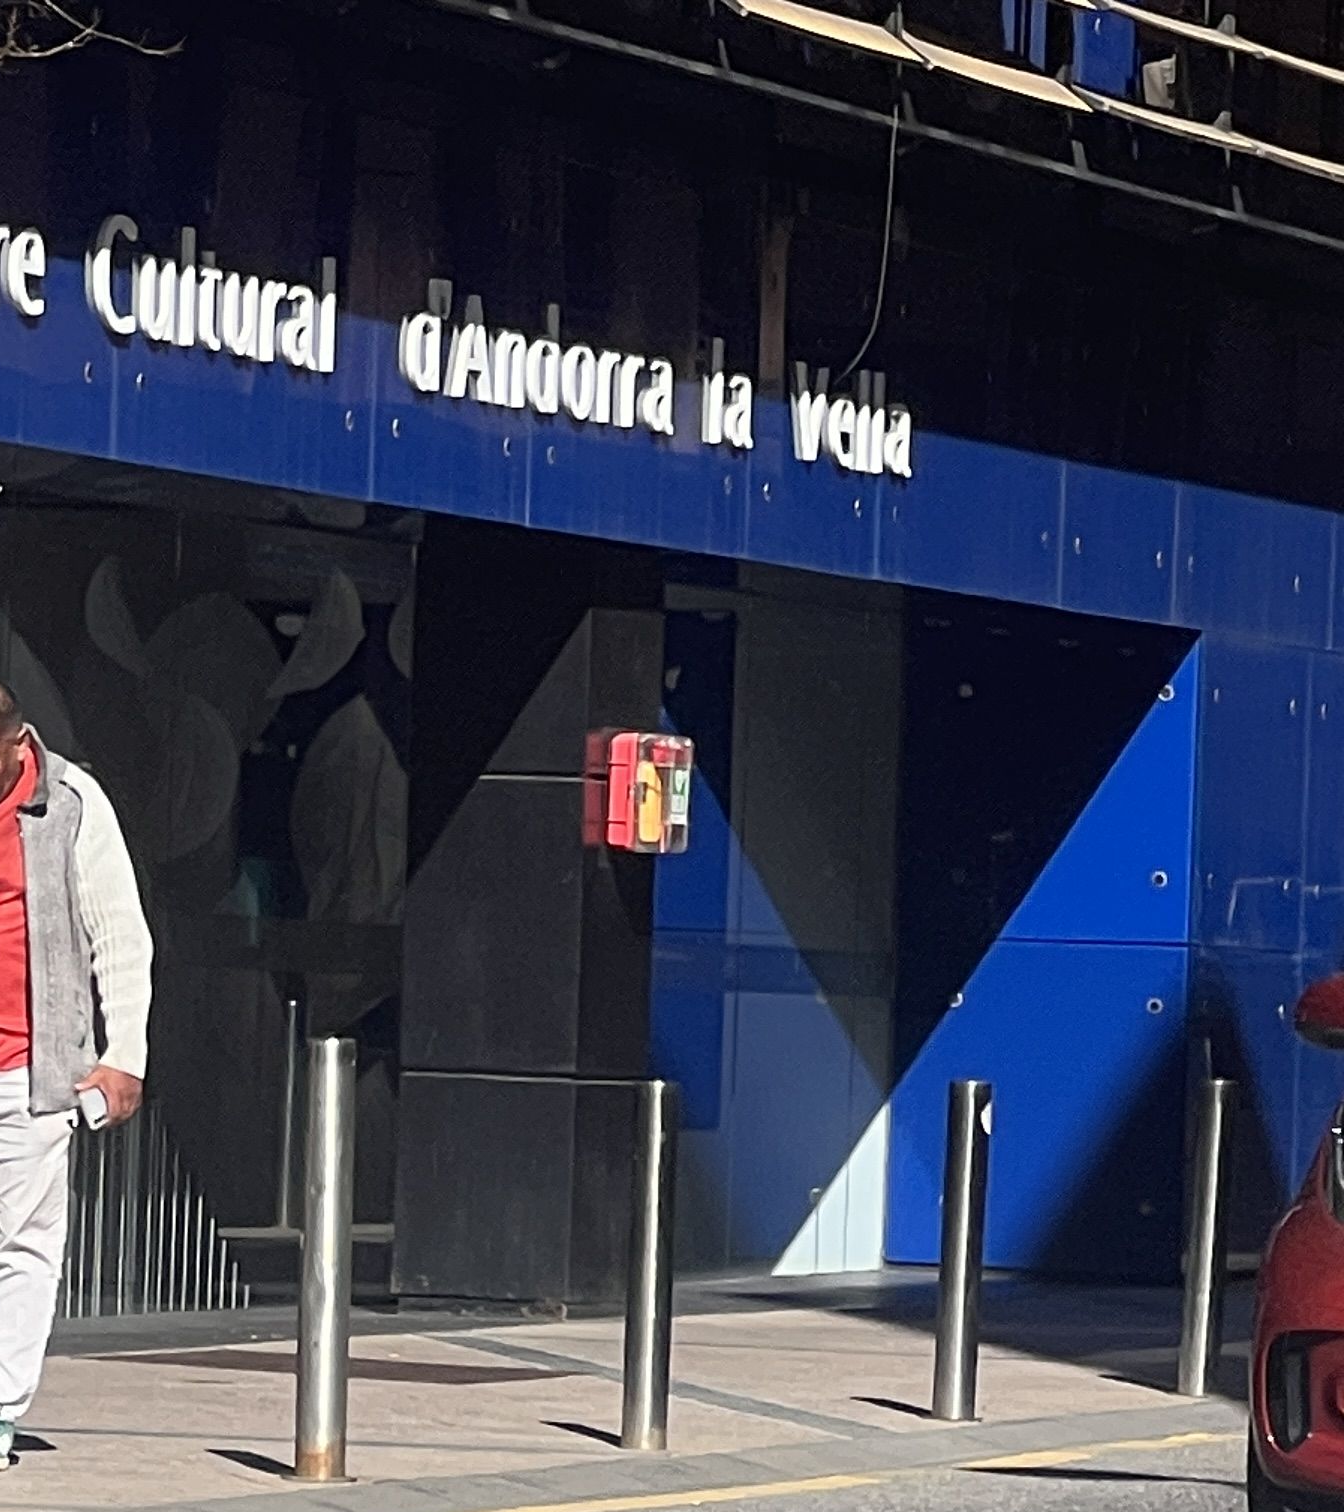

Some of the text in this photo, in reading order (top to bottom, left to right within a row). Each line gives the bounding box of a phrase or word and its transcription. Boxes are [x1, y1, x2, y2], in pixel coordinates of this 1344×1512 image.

[85, 214, 337, 373] Cultural
[398, 279, 674, 436] d'Andorra
[702, 337, 754, 450] la
[790, 361, 912, 478] Vella
